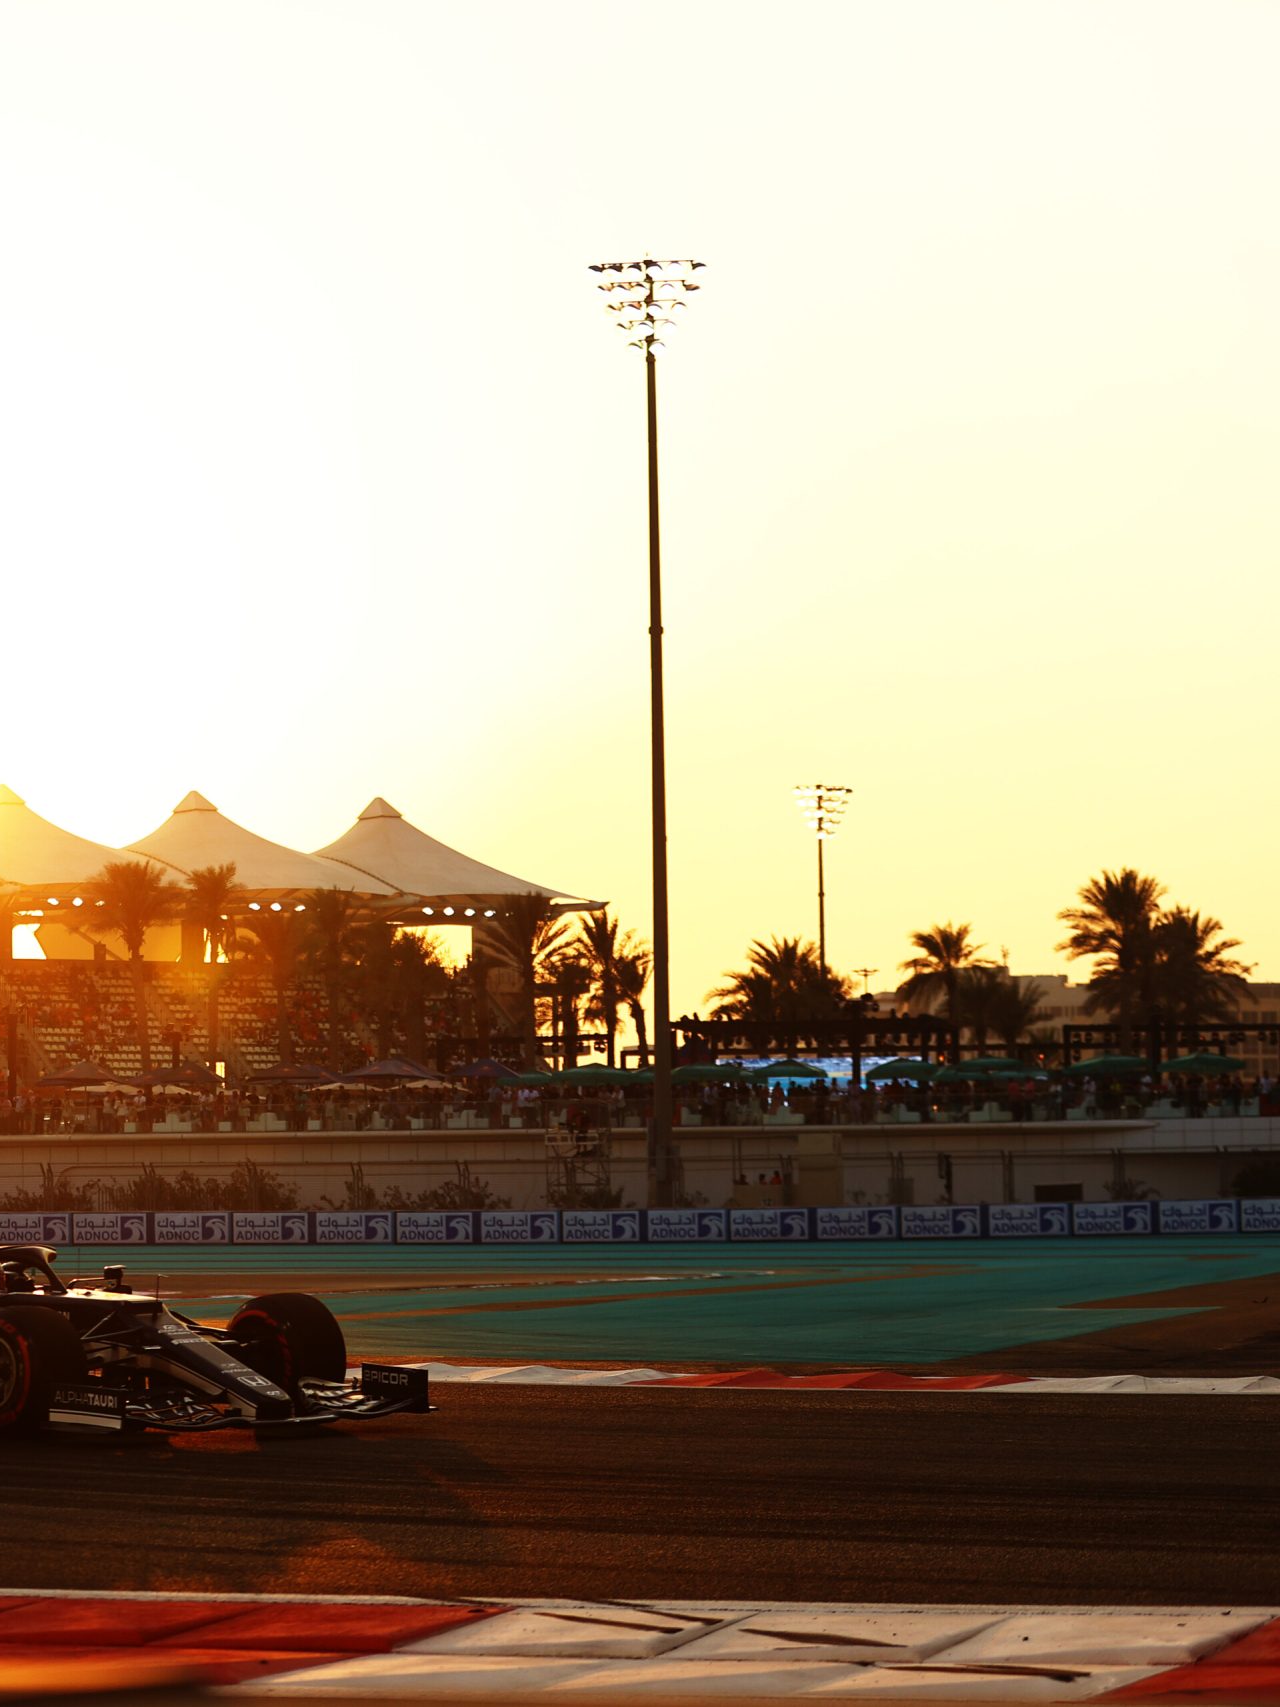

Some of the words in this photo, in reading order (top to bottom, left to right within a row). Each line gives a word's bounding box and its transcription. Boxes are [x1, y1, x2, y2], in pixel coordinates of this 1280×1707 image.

[991, 1222, 1038, 1234] ADNOC
[1075, 1221, 1121, 1232] ADNOC
[1162, 1219, 1207, 1231] ADNOC
[1245, 1217, 1280, 1229] ADNO
[484, 1229, 528, 1240] ADNOC
[565, 1229, 610, 1240] ADNOC
[650, 1228, 696, 1239] ADNOC
[732, 1227, 778, 1238] ADNOC
[820, 1225, 866, 1236] ADNOC
[904, 1224, 950, 1235] ADNOC
[0, 1231, 41, 1241] ADNOC
[76, 1231, 119, 1241] ADNOC
[157, 1231, 199, 1241] ADNOC
[236, 1231, 279, 1240] ADNOC
[320, 1231, 363, 1240] ADNOC
[399, 1231, 443, 1240] ADNOC
[54, 1390, 118, 1409] ALPHATAURI
